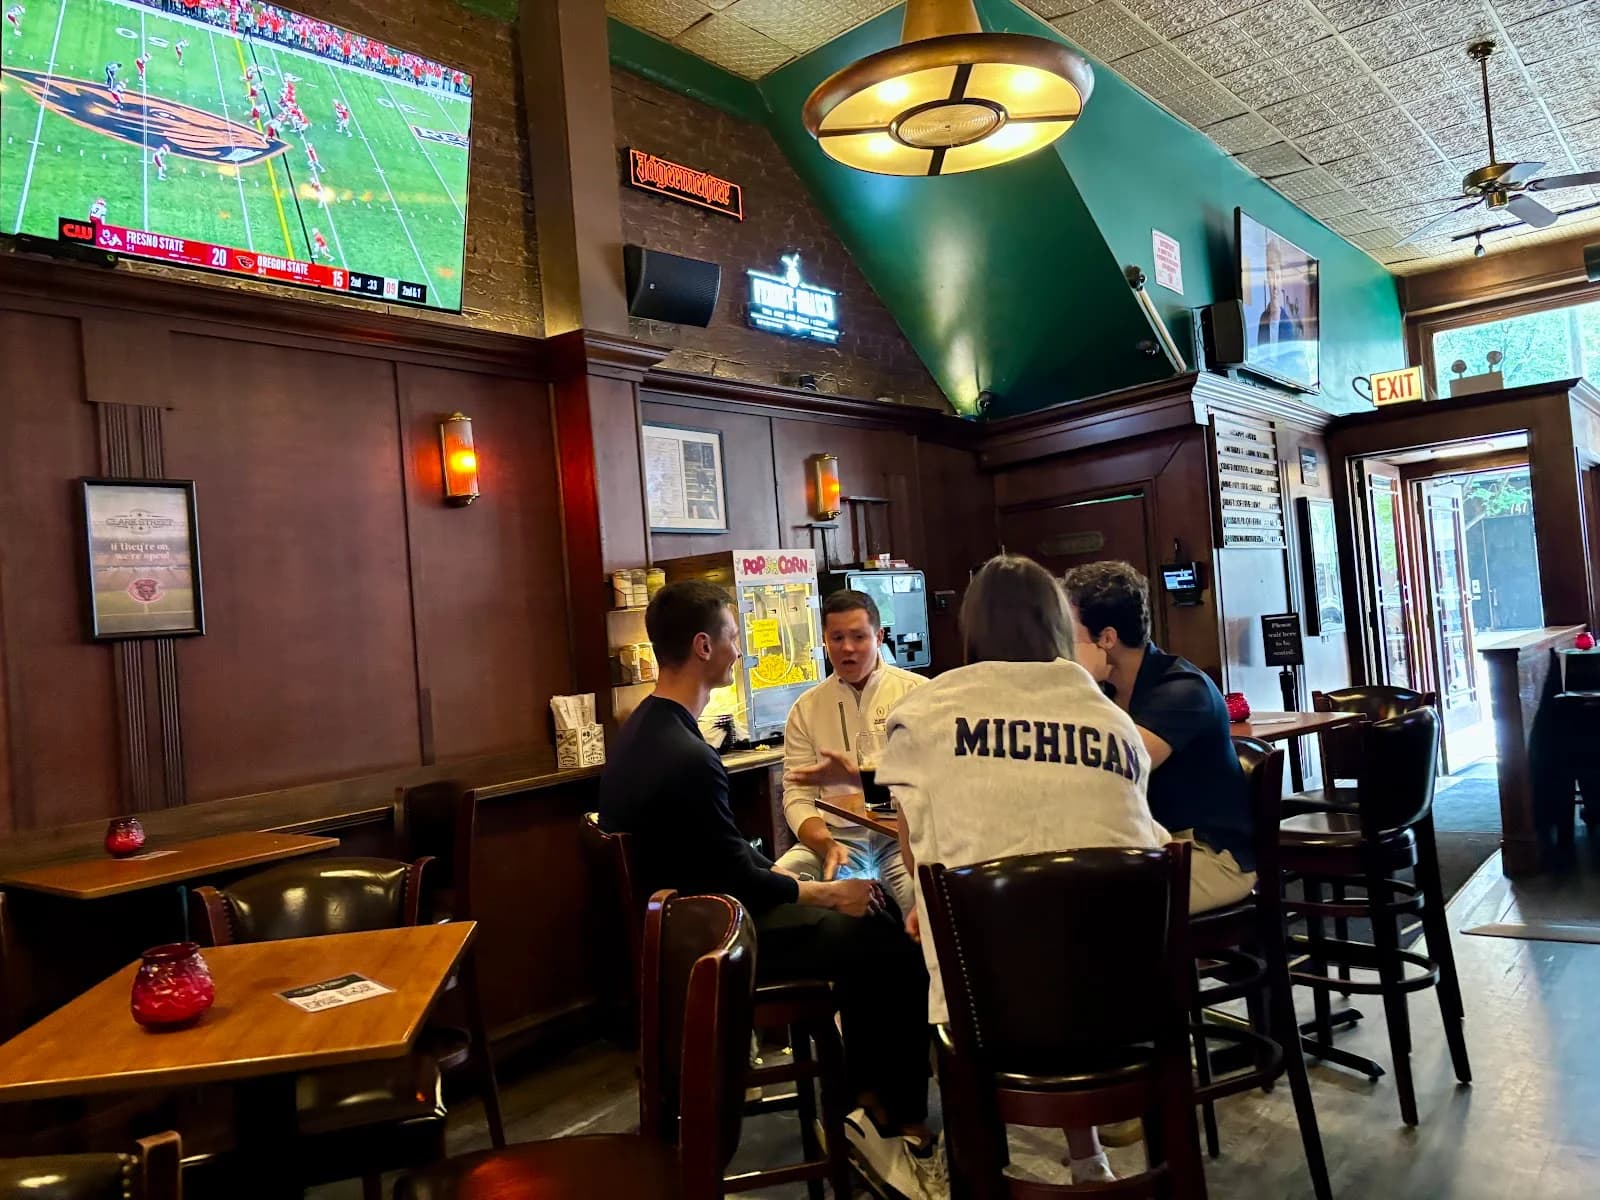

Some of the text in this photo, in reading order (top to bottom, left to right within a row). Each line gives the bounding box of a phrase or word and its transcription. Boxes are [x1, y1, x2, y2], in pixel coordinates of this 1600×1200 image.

[126, 230, 185, 252] FRESNO STATE
[212, 248, 227, 266] 20
[257, 255, 309, 276] OREGON STATE
[332, 270, 344, 287] 15
[1376, 373, 1414, 401] EXIT
[742, 555, 808, 576] POP CORN
[954, 717, 1141, 785] MICHIGAN
